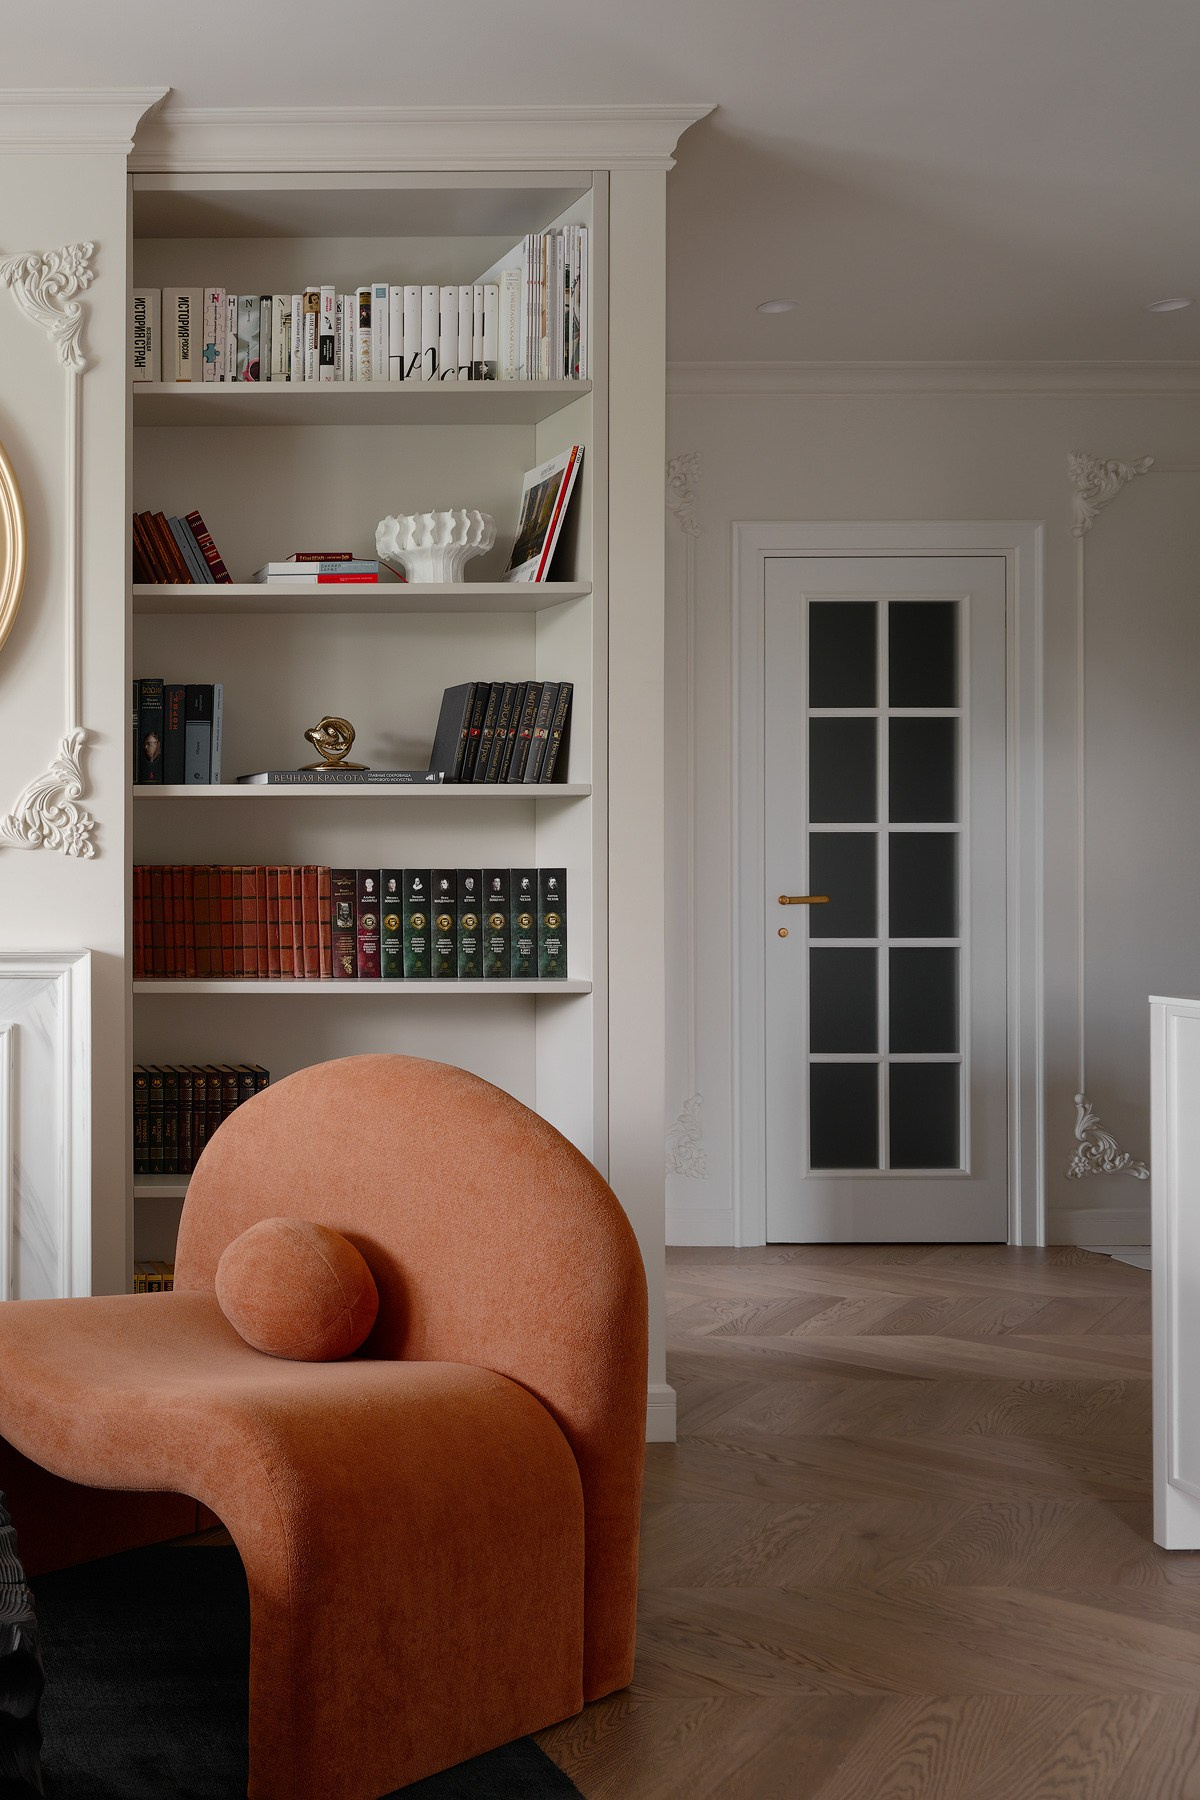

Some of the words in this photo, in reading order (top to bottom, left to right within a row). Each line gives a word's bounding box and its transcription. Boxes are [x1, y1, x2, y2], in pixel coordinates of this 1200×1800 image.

[134, 298, 146, 338] ИСТОРИЯ
[178, 297, 190, 338] ИСТОРИЯ
[134, 340, 146, 368] СТРАН
[500, 704, 510, 726] ЗУСАК
[523, 690, 536, 725] МИТЧЕЛЛ
[538, 691, 552, 726] МИТЧЕЛЛ
[481, 740, 492, 763] Игрок
